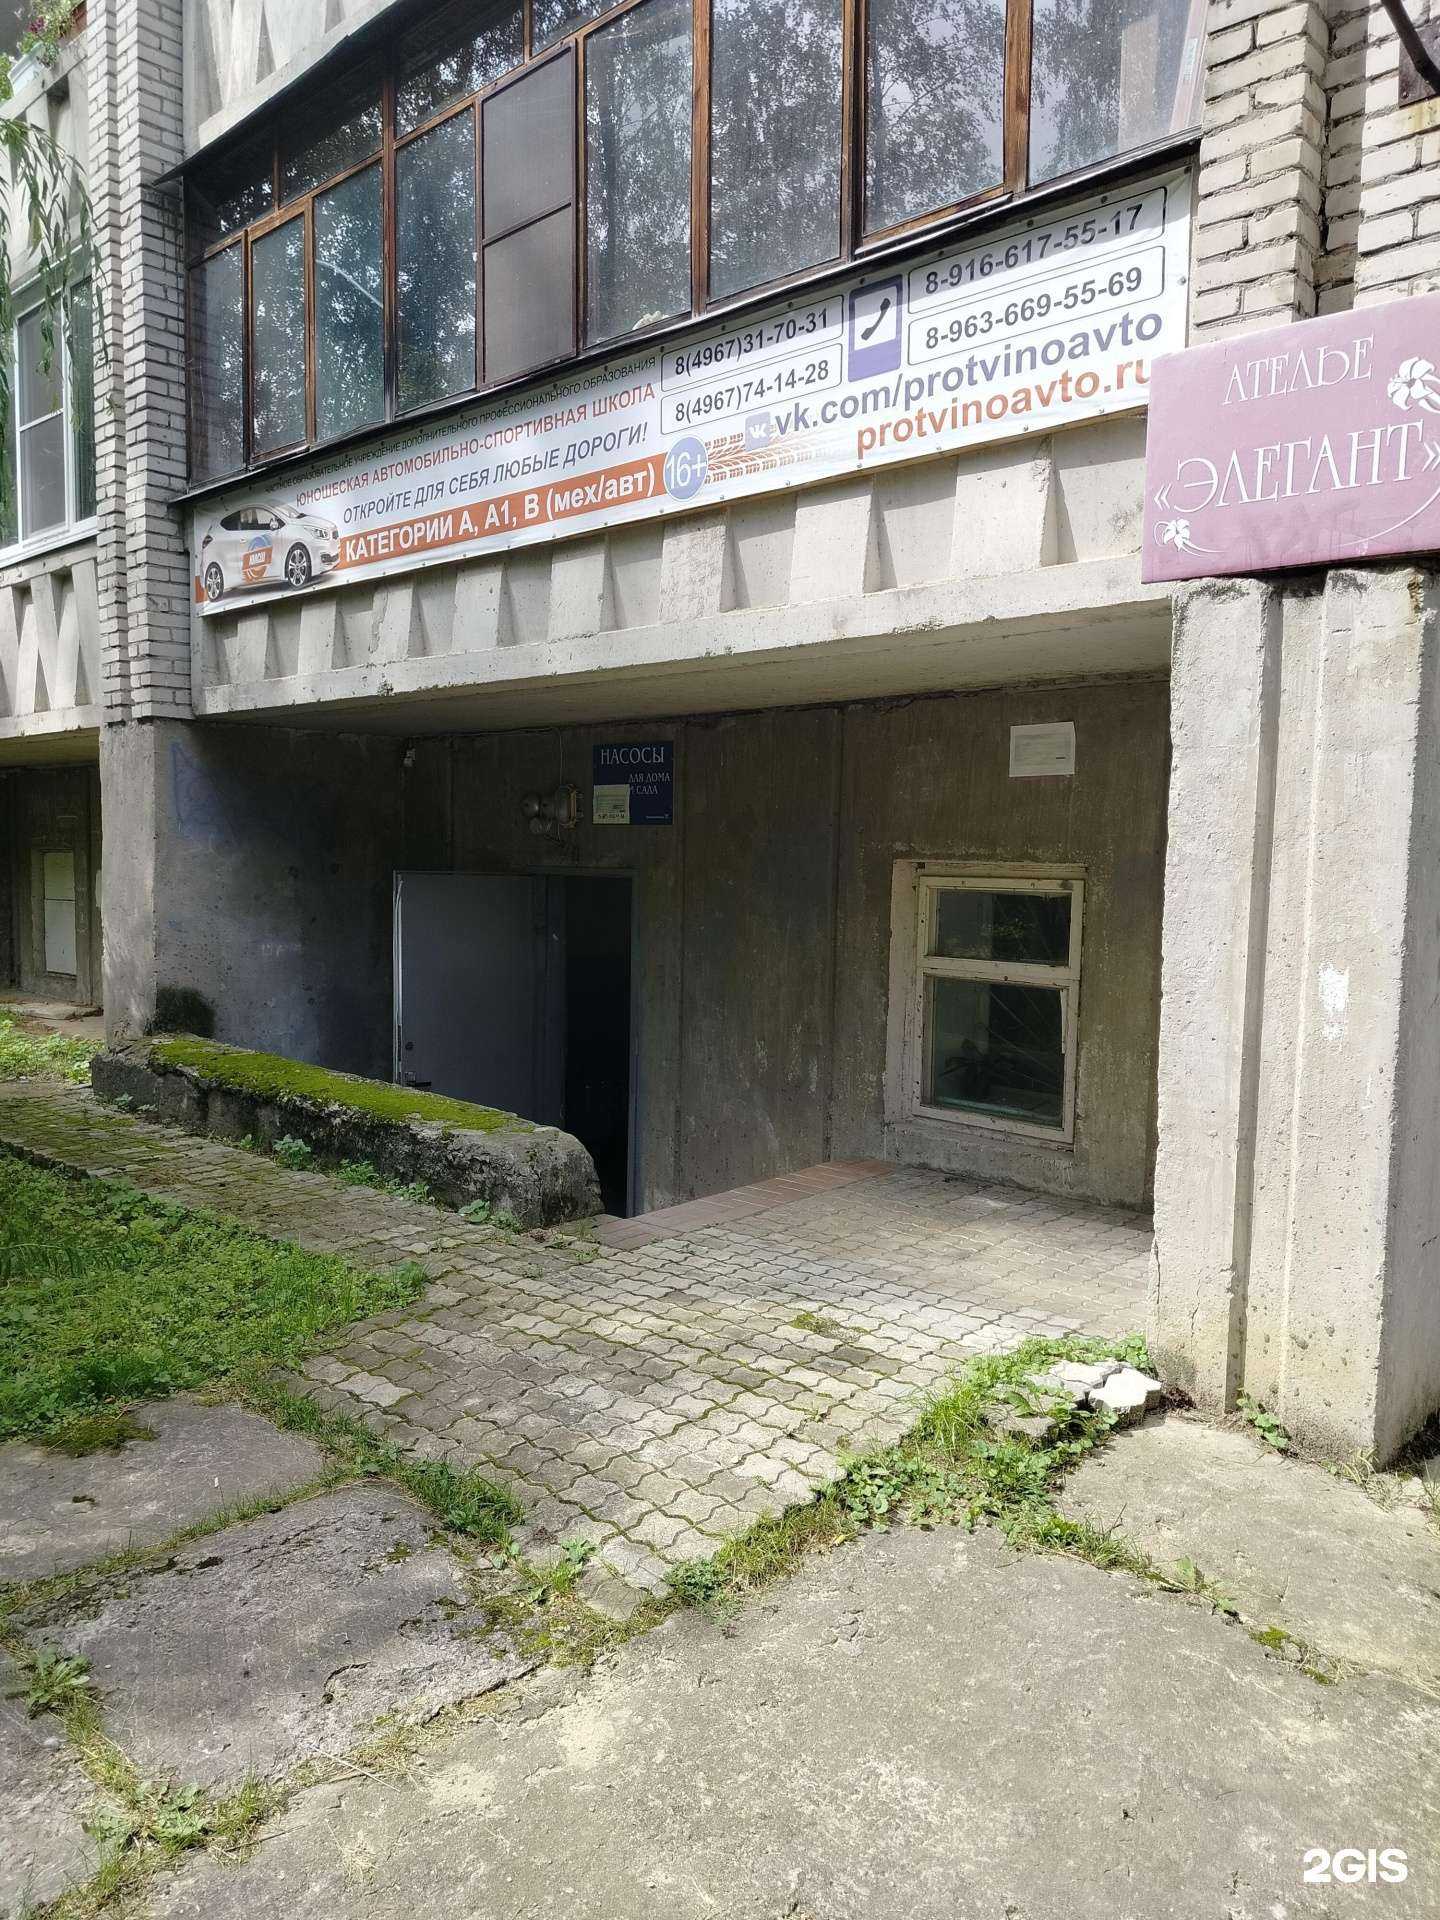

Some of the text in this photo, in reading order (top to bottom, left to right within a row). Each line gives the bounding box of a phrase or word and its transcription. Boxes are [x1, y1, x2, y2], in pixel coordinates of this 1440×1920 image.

[925, 203, 1143, 295] 8-916-617-55-17
[675, 308, 827, 377] 8(4967)31-70-31
[925, 266, 1142, 351] 8-963-669-55-69
[675, 359, 829, 424] 8(4967)74-14-28
[775, 312, 1162, 435] vk.com/protvinoavto
[857, 359, 1150, 460] protvinoavto.ru
[1222, 335, 1375, 406] АТЕЛЬЕ
[293, 459, 353, 485] ОБРАЗОВАТЕЛЬНОЕ
[354, 443, 400, 467] УЧРЕЖДЕНИЕ
[401, 417, 478, 450] ДОПОЛНИТЕЛЬНОГО
[480, 382, 581, 425] ПРОФЕССИОНАЛЬНОГО
[583, 357, 656, 391] ОБРАЗОВАНИЯ
[296, 382, 655, 507] ЮНОШЕСКАЯ АВТОМОБИЛЬНО-СПОРТИВНАЯ ШКОЛА
[343, 421, 648, 524] ОТКРОЙТЕ ДЛЯ СЕБЯ ЛЮБЫЕ ДОРОГИ!
[346, 514, 453, 562] КАТЕГОРИИ
[546, 462, 655, 521] (мех/авт)
[666, 451, 707, 488] 16+
[600, 746, 665, 765] НАСОСЫ
[628, 772, 671, 784] ДЛЯ ДОМА
[636, 785, 659, 795] САДА
